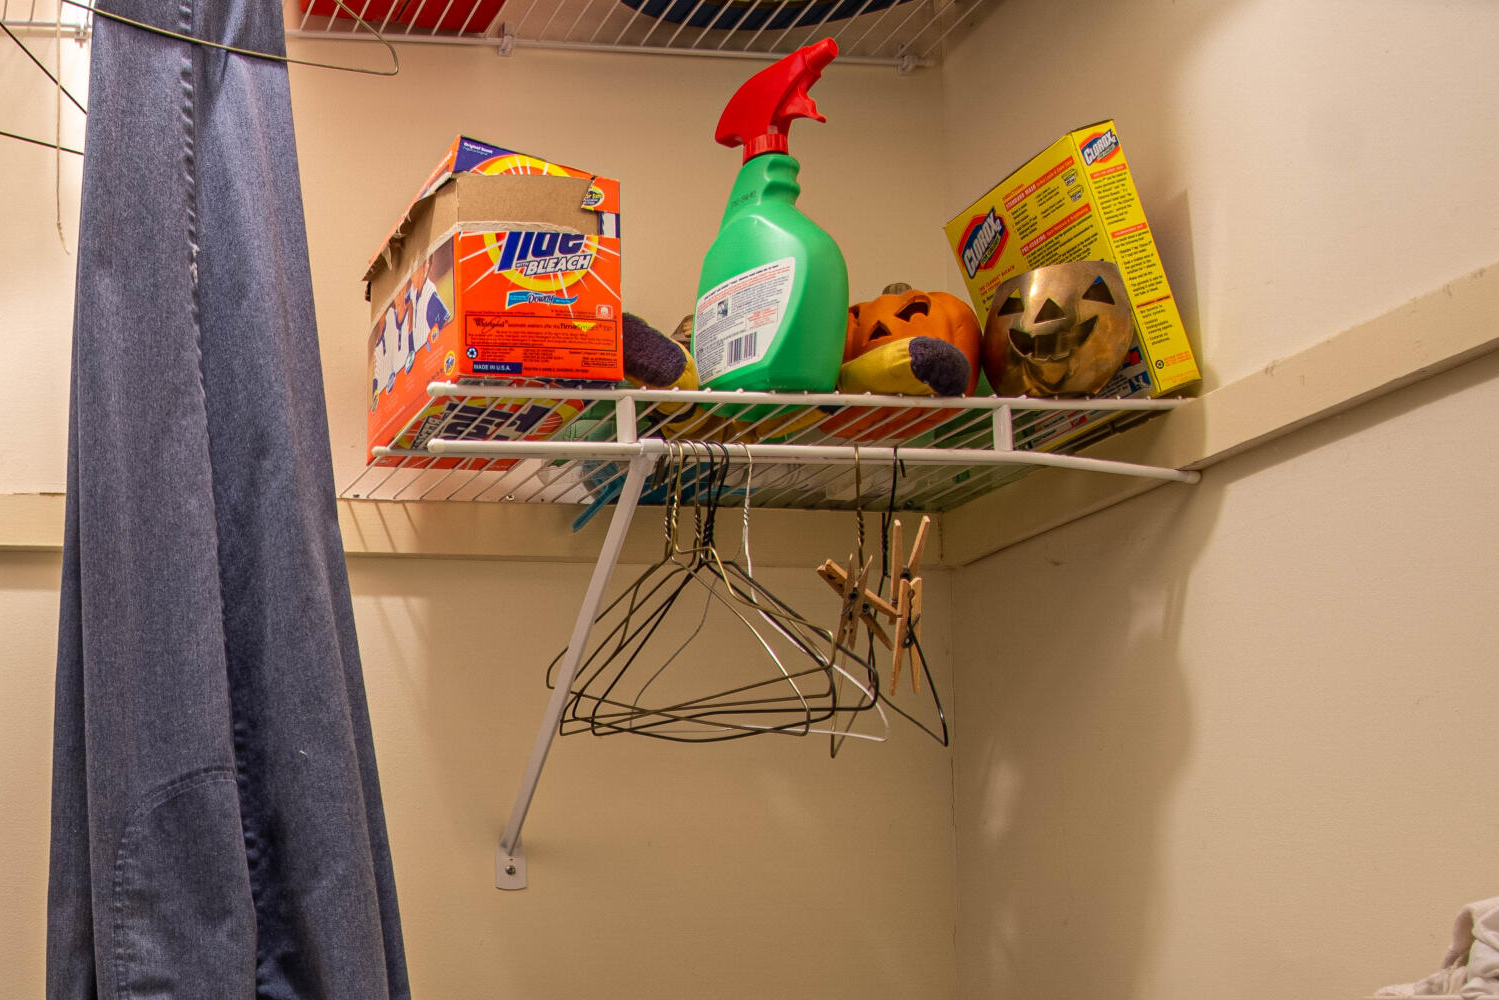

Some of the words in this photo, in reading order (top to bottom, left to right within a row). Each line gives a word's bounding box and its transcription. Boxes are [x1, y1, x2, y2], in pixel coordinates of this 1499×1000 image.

[1083, 129, 1113, 166] CLOROX
[963, 208, 999, 279] CLOROX
[525, 254, 592, 276] BLEACH
